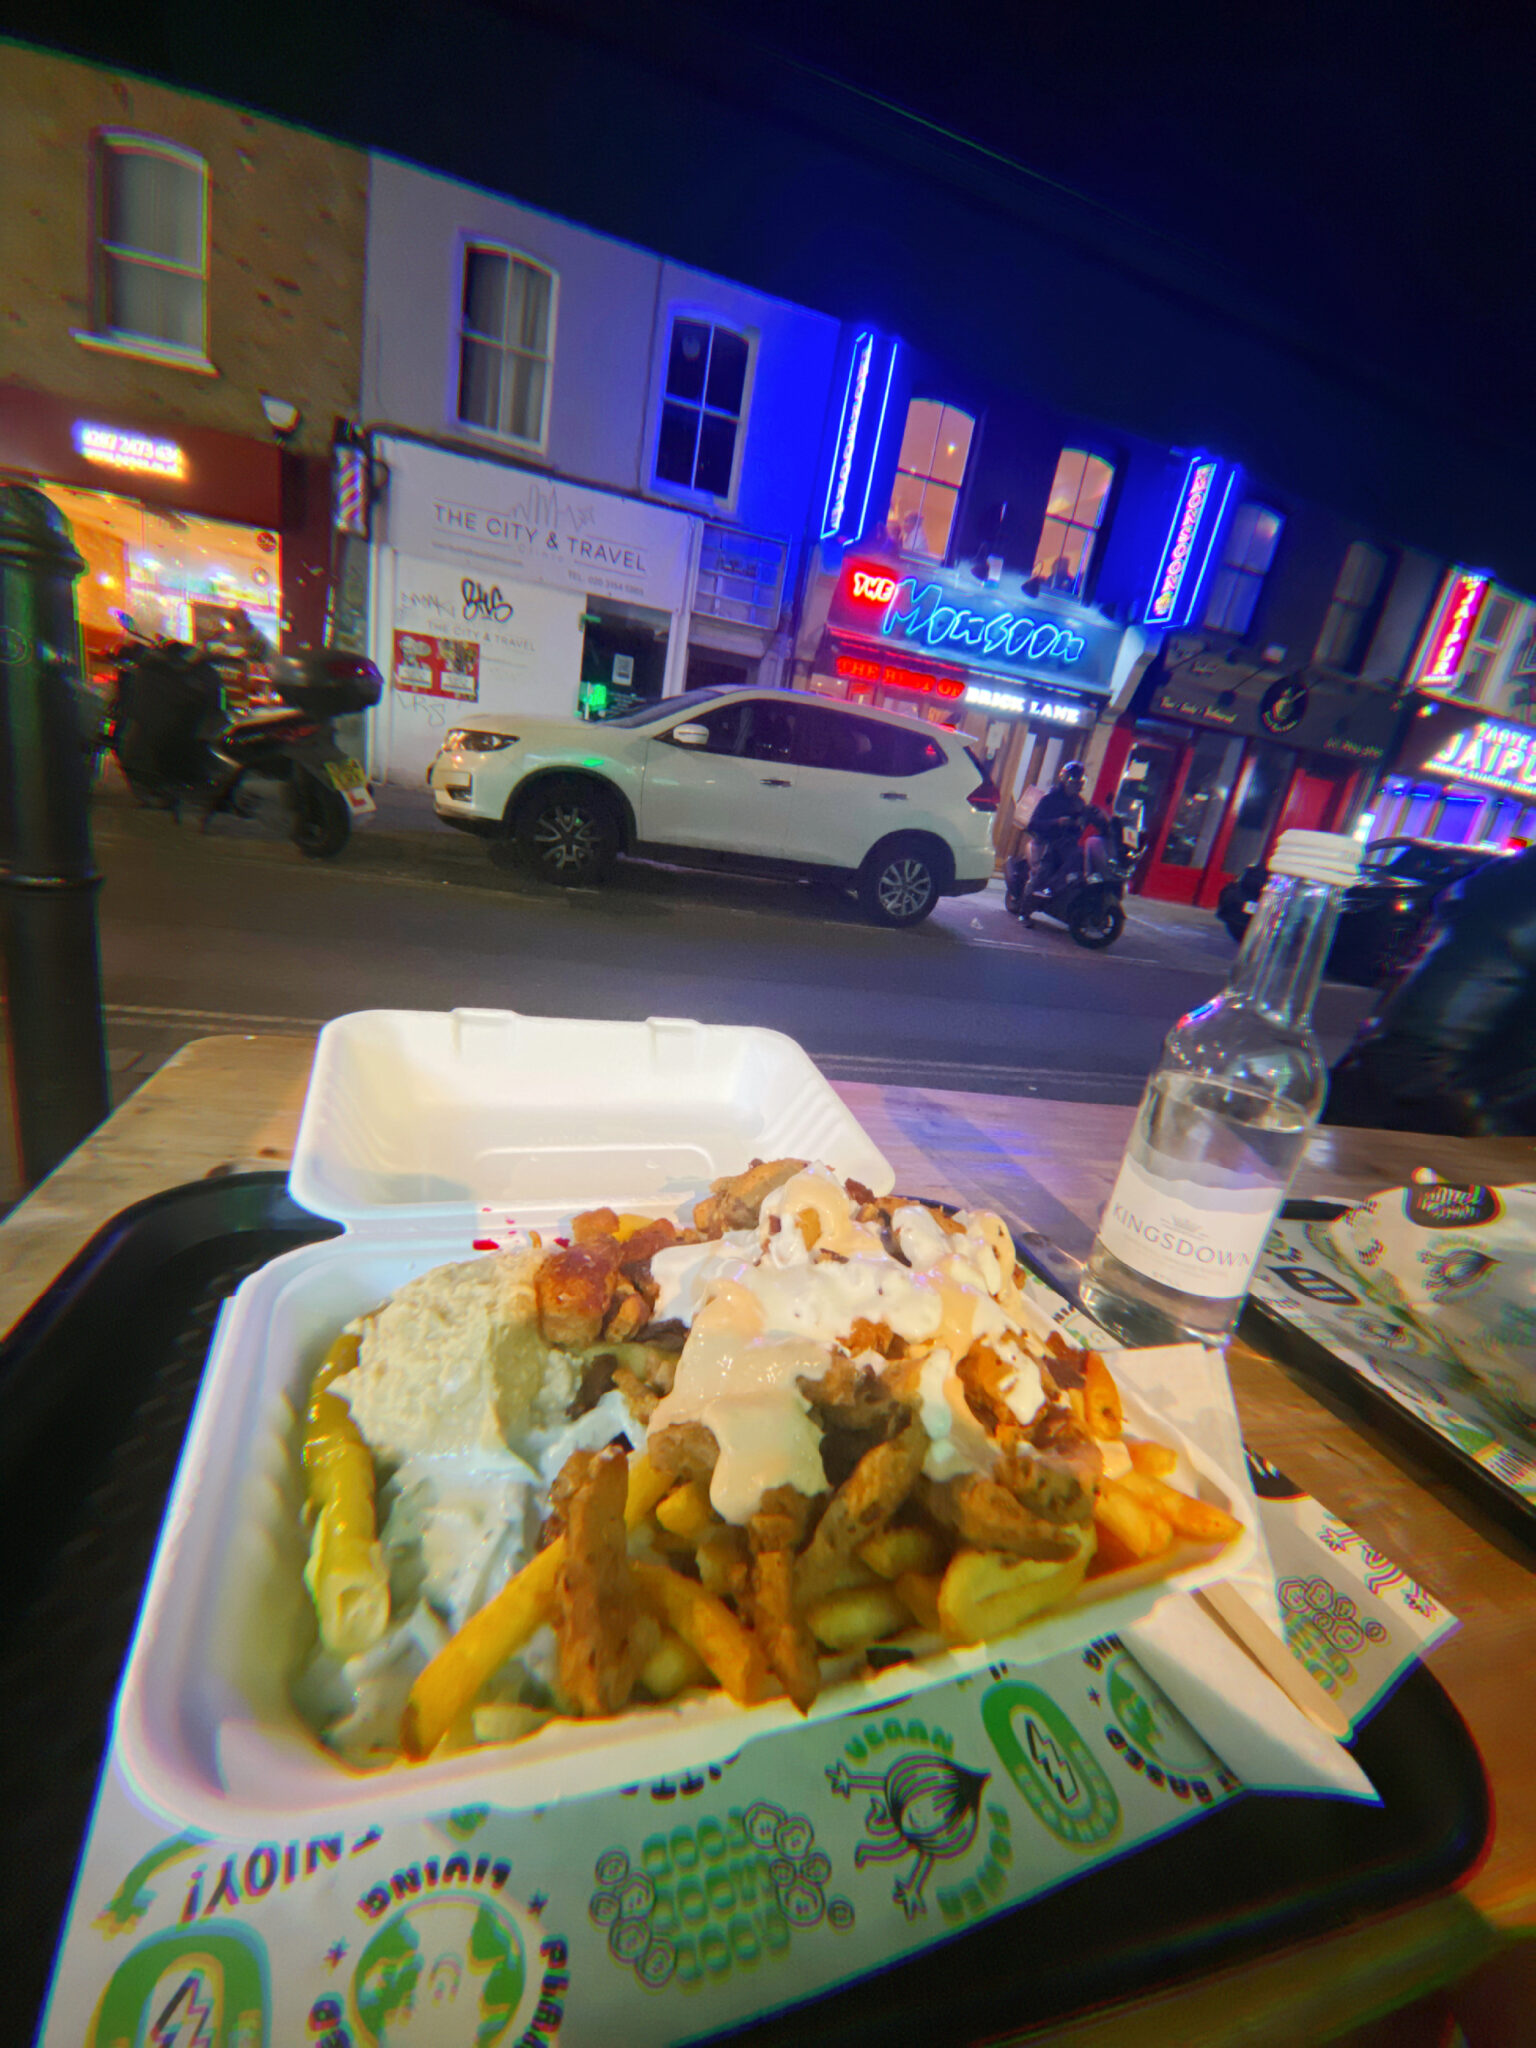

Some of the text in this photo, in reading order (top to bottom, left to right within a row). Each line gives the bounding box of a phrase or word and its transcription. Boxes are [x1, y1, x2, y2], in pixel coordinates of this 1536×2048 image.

[434, 504, 646, 571] THE CITY & TRAVEL
[854, 572, 897, 602] THE
[454, 626, 480, 639] CITY
[495, 635, 536, 652] TRAVEL
[1432, 589, 1476, 675] JAIPUR
[836, 656, 881, 681] THE
[963, 686, 1027, 712] BRICK
[1029, 701, 1081, 724] LANE
[1475, 722, 1530, 750] TASTE
[1113, 1202, 1252, 1267] KINGSDOWN
[846, 1721, 953, 1763] VEGAN
[357, 1856, 511, 1919] LIVING
[937, 1805, 1010, 1916] POWER
